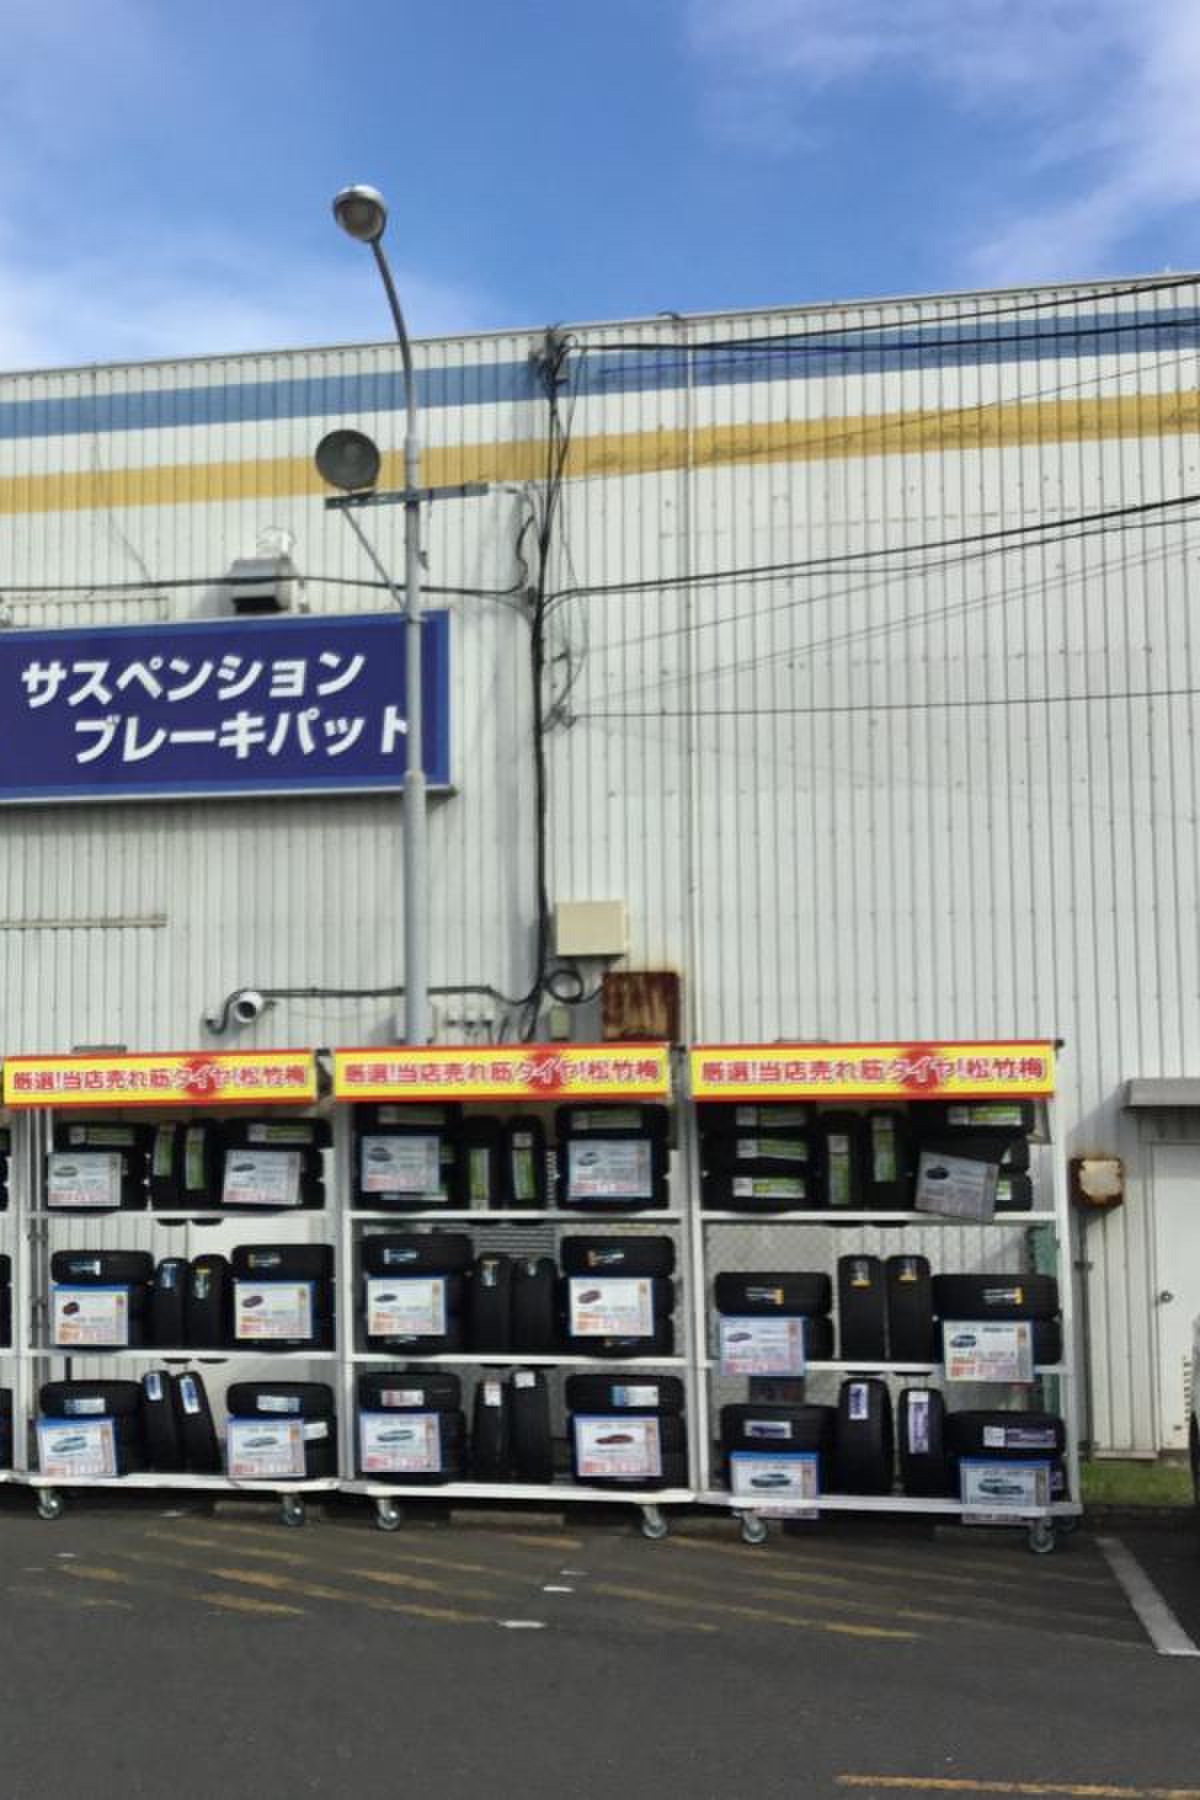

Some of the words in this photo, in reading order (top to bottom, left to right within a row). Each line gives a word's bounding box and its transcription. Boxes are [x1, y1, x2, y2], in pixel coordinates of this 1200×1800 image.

[21, 652, 365, 708] サスペンション
[74, 705, 407, 764] ブレーキパット
